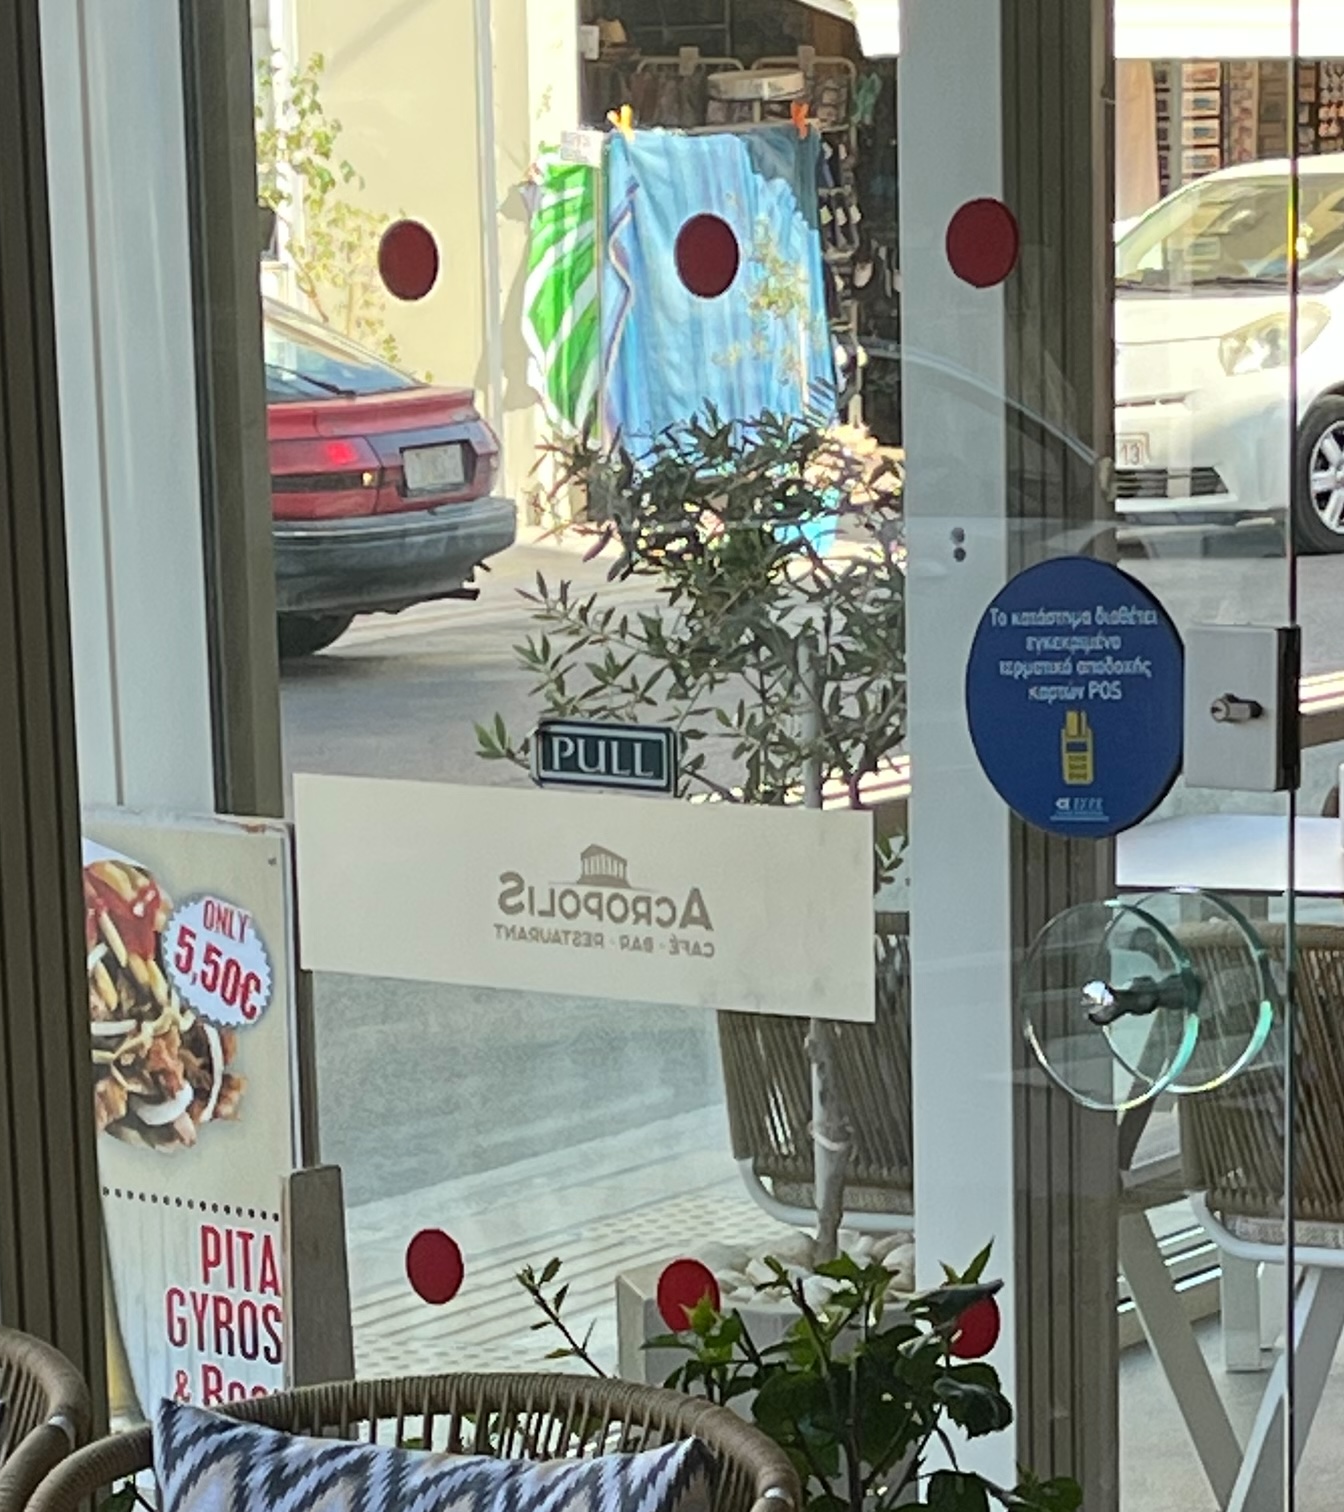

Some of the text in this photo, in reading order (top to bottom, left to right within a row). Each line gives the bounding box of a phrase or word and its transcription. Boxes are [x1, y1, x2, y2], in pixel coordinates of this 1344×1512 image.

[989, 607, 1007, 626] Το
[1012, 603, 1092, 630] κατάστημα
[1088, 680, 1123, 700] POS
[551, 736, 655, 777] PULL
[203, 899, 250, 944] ONLY
[200, 1224, 281, 1297] PITA
[165, 1286, 283, 1365] GYROS
[174, 1369, 192, 1403] &
